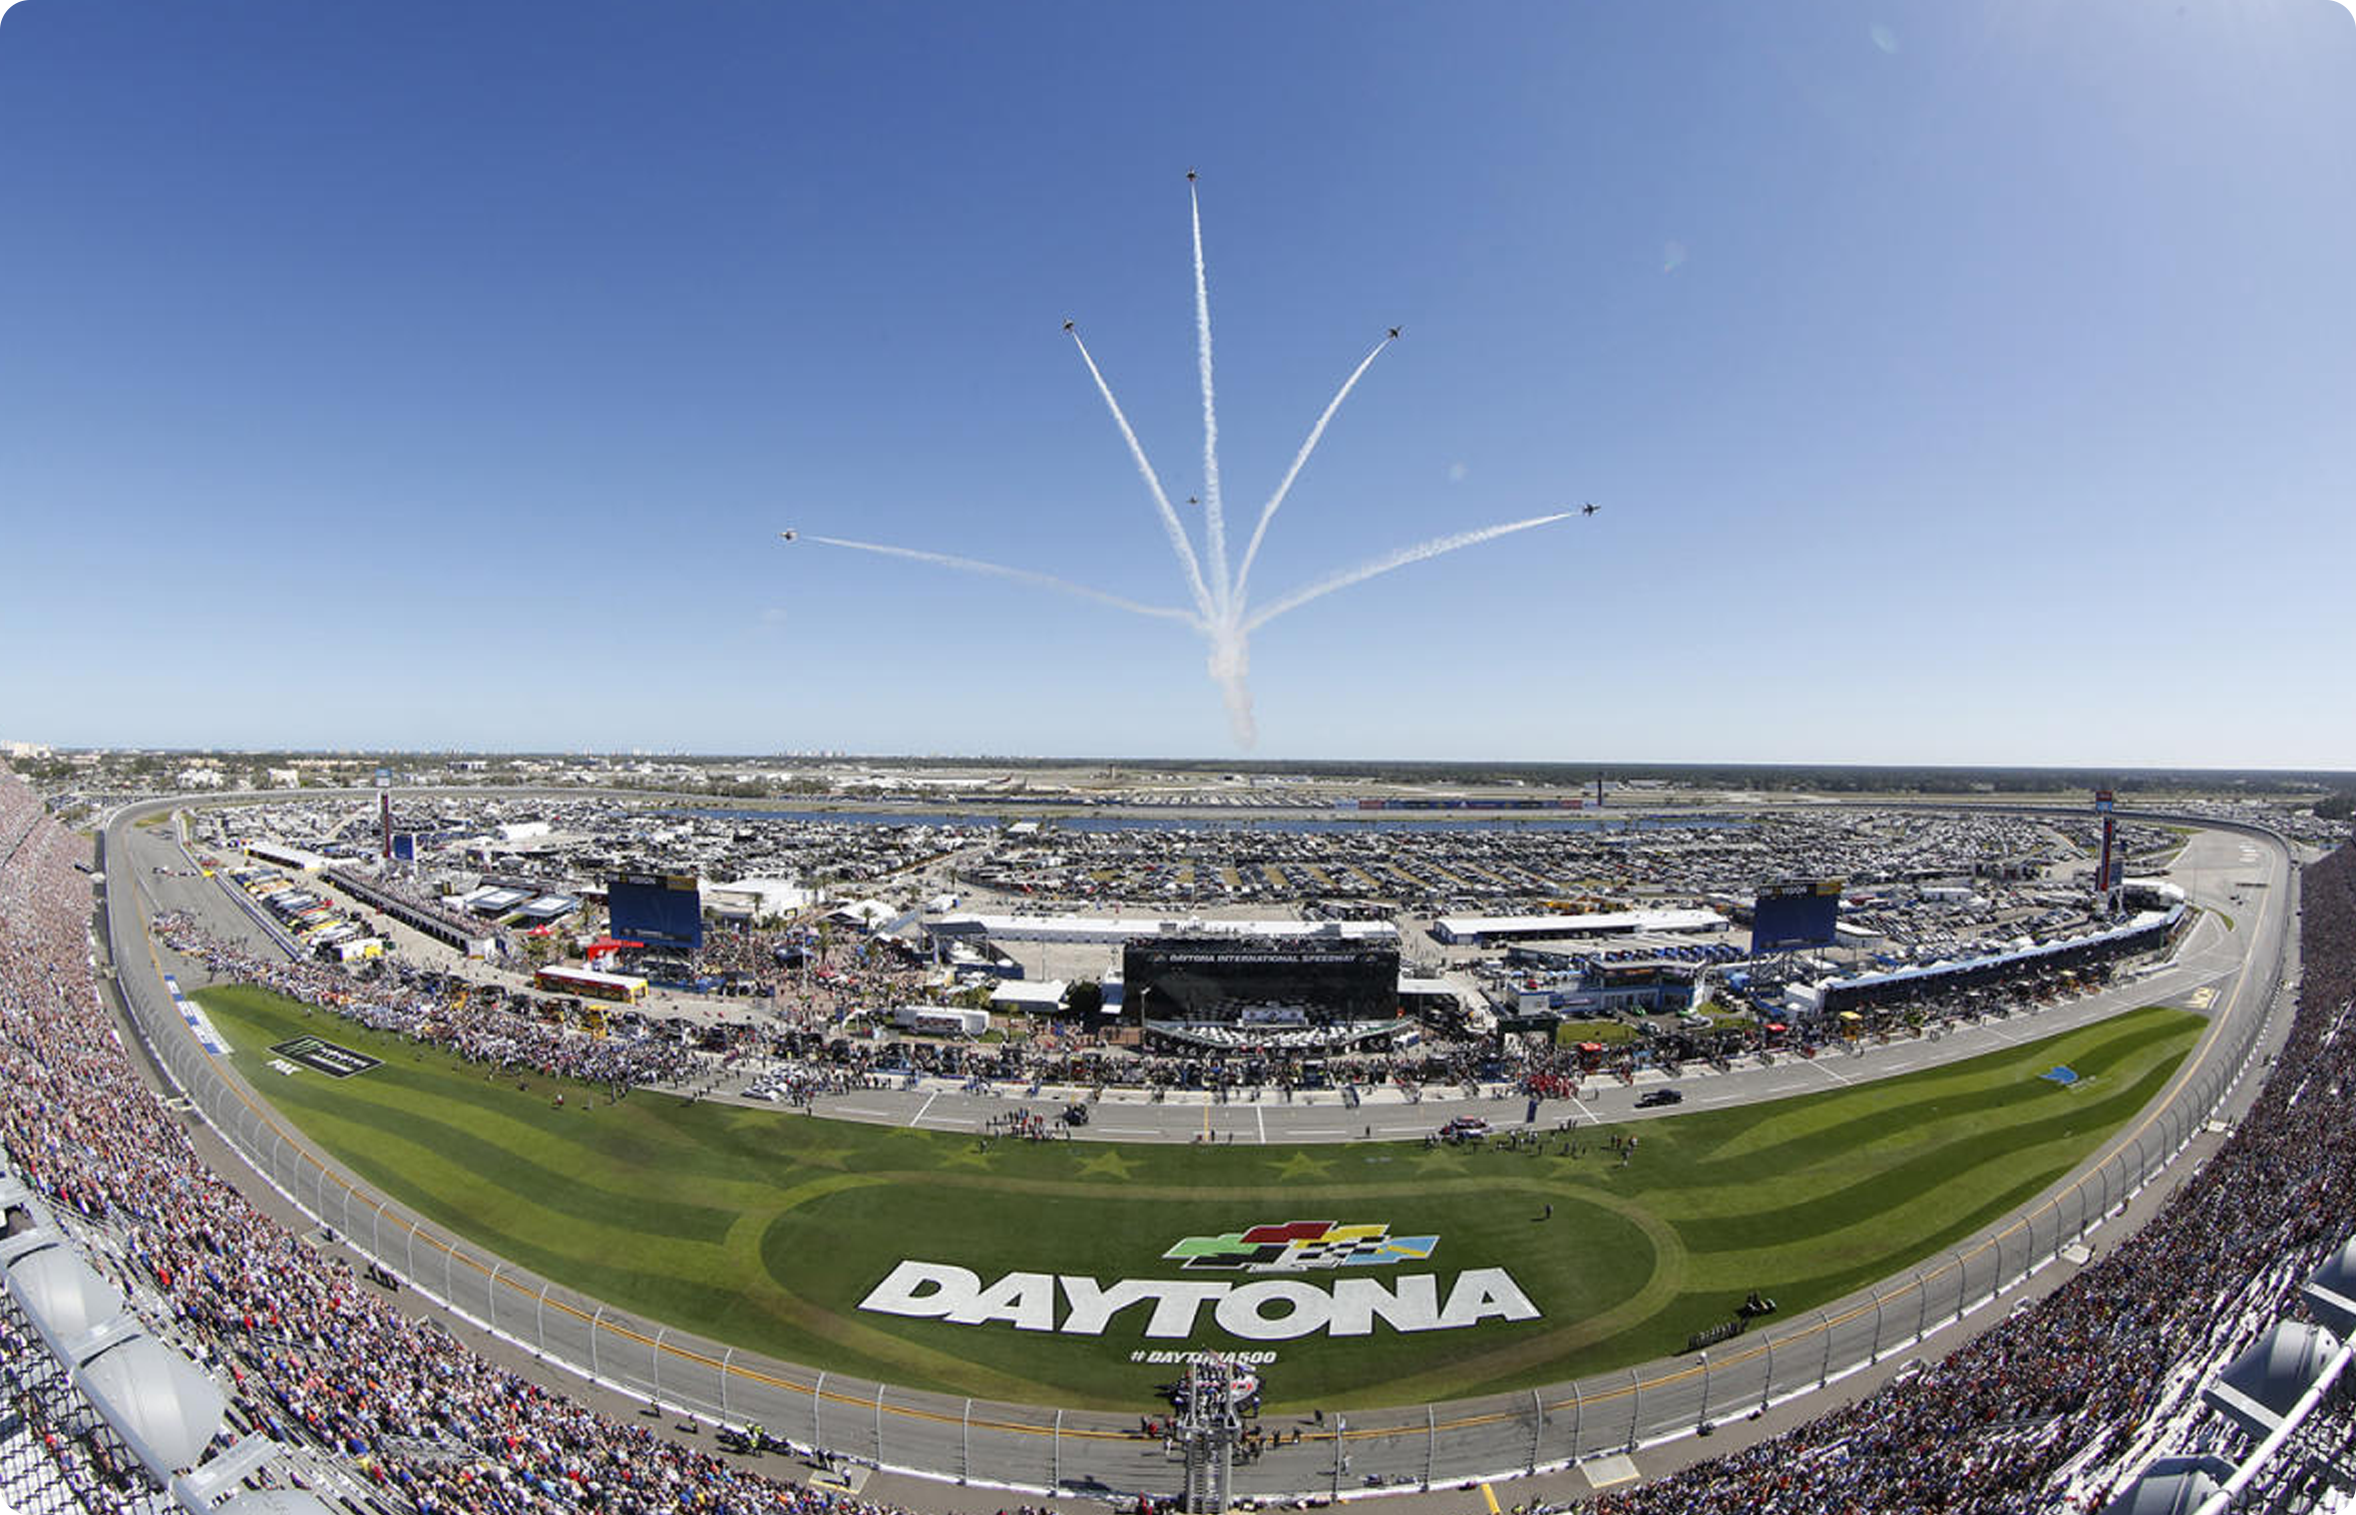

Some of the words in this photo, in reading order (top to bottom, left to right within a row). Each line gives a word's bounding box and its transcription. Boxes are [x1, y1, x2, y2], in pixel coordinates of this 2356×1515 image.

[1169, 954, 1216, 962] DAYTONA
[1217, 954, 1299, 962] INTERNATIONAL
[1301, 954, 1356, 962] SPEEDWAY
[857, 1260, 1542, 1340] DAYTONA
